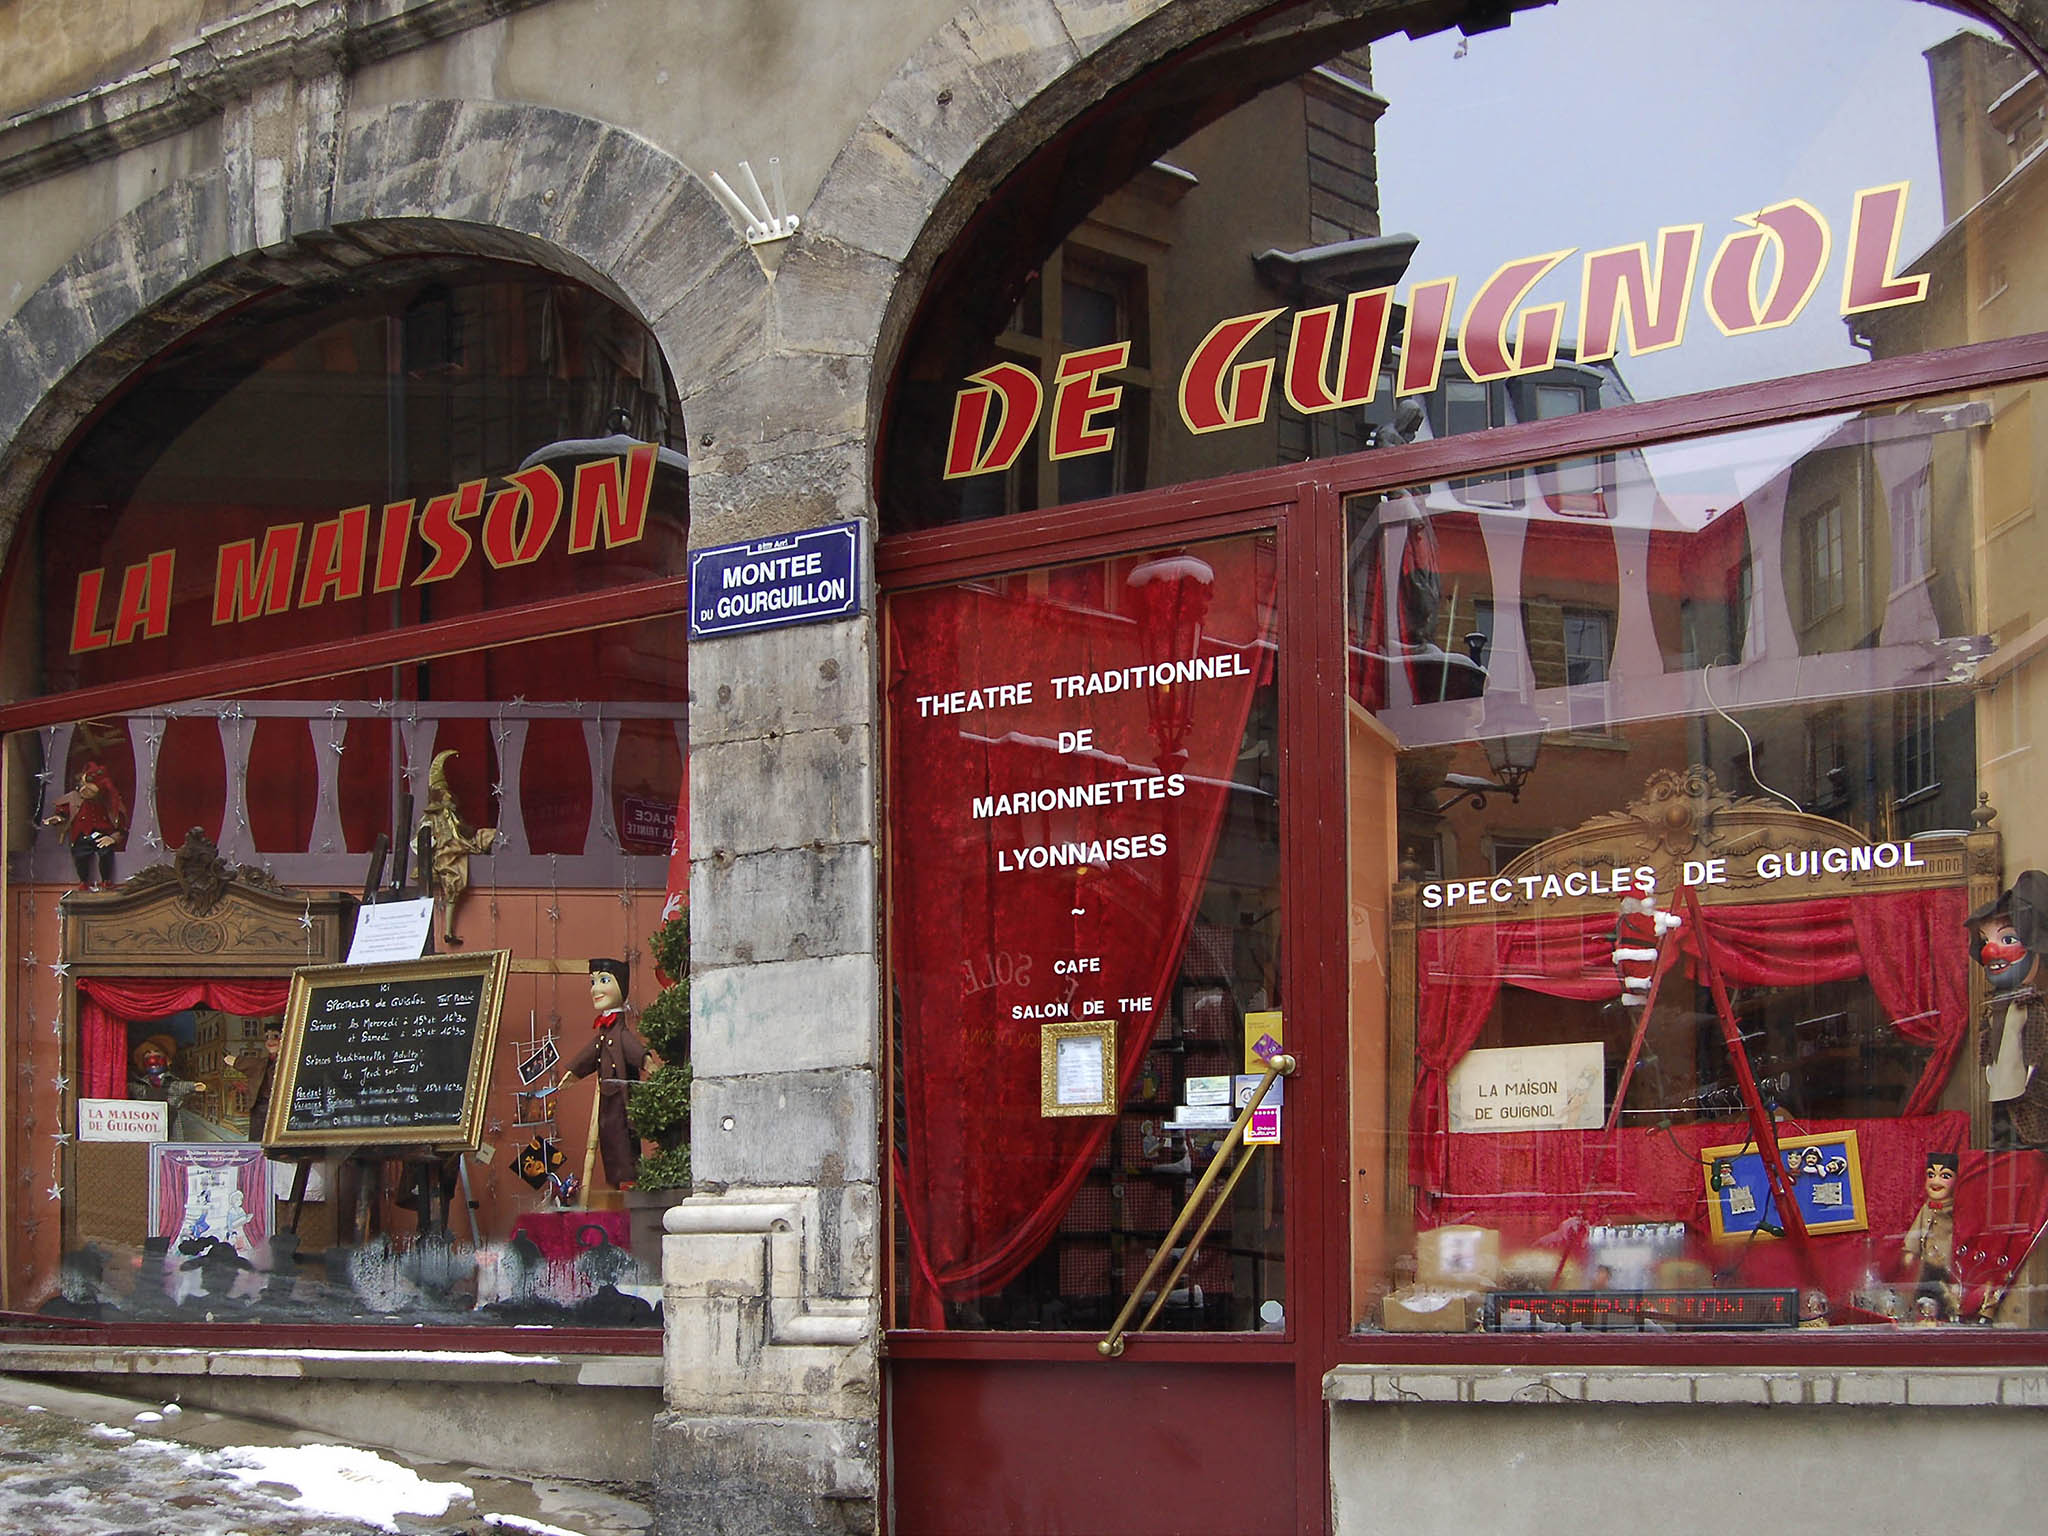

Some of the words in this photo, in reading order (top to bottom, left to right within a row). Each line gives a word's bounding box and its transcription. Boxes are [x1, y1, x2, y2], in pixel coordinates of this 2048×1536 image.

[943, 341, 1131, 480] DE
[1178, 180, 1931, 435] GUIGNOL
[69, 549, 176, 654] LA
[212, 442, 659, 626] MAISON
[722, 552, 822, 589] MONTEE
[700, 608, 714, 622] DU
[717, 578, 845, 619] GOURGUILLON
[916, 682, 1033, 717] THEATRE
[1051, 653, 1250, 700] TRADITIONNEL
[1058, 729, 1093, 754] DE
[972, 774, 1186, 819] MARIONNETTES
[998, 834, 1167, 872] LYONNAISES
[1422, 865, 1656, 909] SPECTACLES
[1683, 860, 1727, 886] DE
[1756, 842, 1925, 880] GUIGNOL
[1053, 957, 1100, 975] CAFE
[1012, 1002, 1068, 1019] SALON
[1083, 1001, 1105, 1015] DE
[1118, 997, 1152, 1012] THE
[1478, 1084, 1498, 1098] LA
[88, 1109, 104, 1119] LA
[108, 1110, 160, 1120] MAISON
[89, 1121, 103, 1131] DE
[107, 1120, 160, 1133] GUIGNOL
[1475, 1107, 1493, 1120] DE
[1500, 1103, 1555, 1119] GUIGNOL
